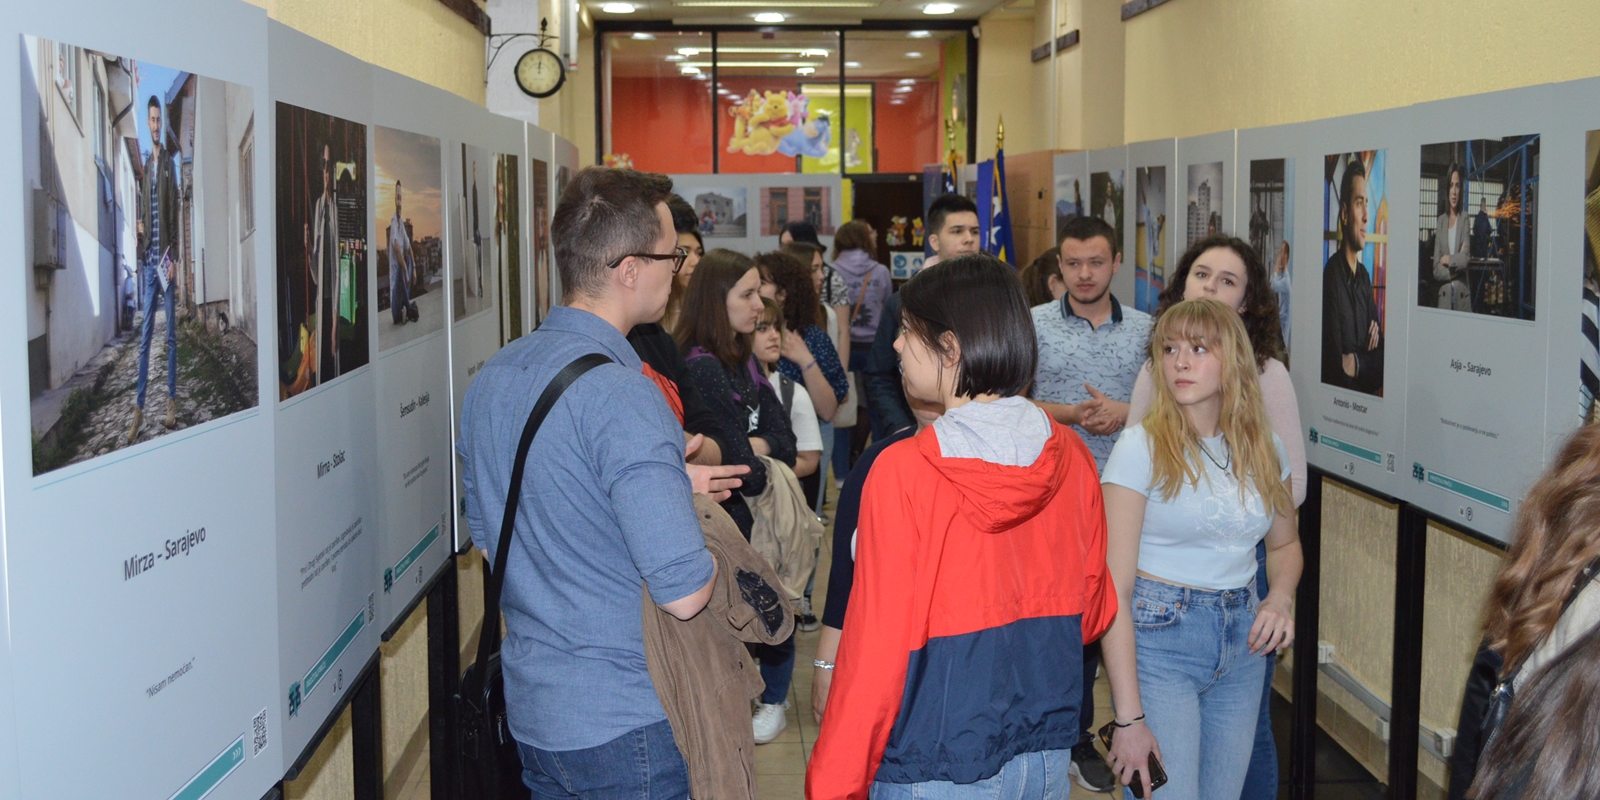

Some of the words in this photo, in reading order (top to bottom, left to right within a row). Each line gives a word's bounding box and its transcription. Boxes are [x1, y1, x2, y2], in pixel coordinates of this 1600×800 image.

[1450, 359, 1462, 372] Asja
[1467, 361, 1492, 377] Sarajevo
[124, 552, 154, 581] Mirza
[165, 526, 206, 560] Sarajevo
